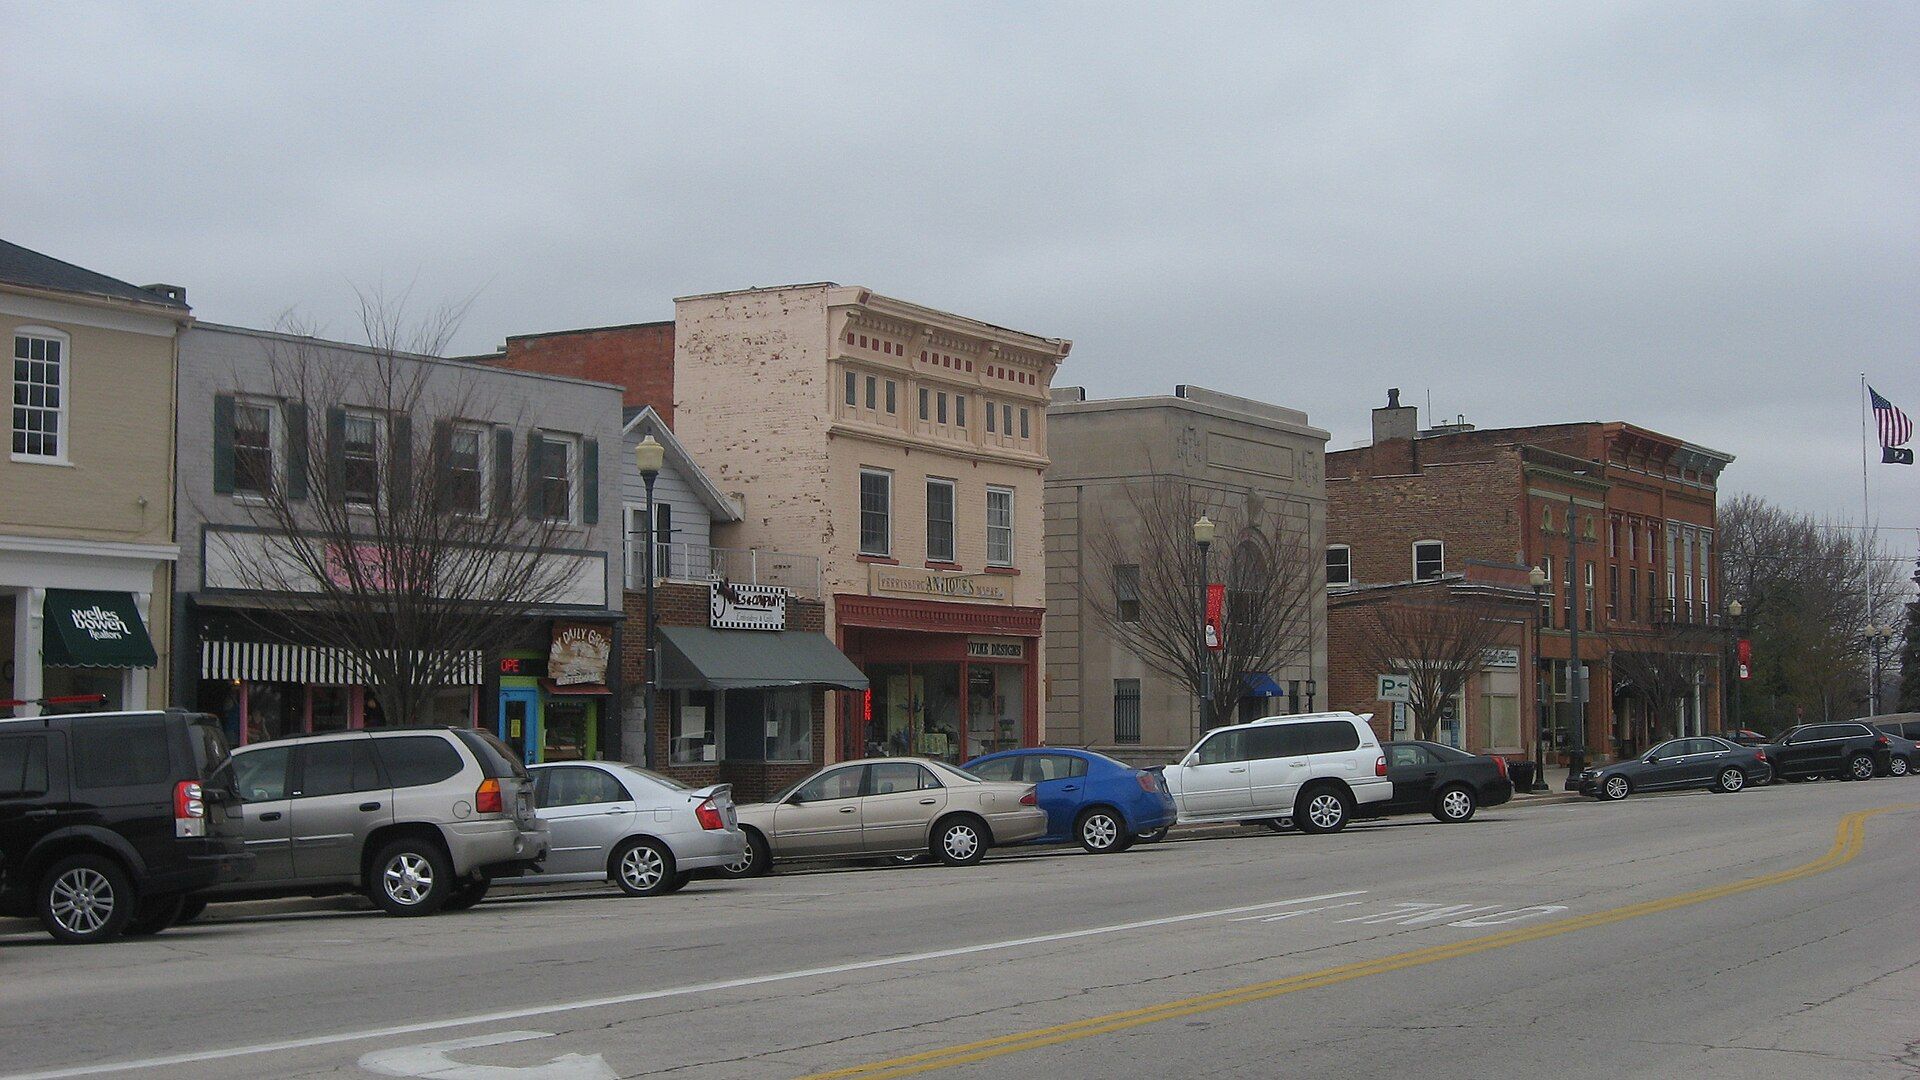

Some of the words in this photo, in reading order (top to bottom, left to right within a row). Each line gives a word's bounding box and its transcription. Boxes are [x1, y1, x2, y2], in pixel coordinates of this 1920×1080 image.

[71, 605, 120, 621] welles
[71, 613, 132, 635] bowen
[88, 628, 123, 641] Realtors
[562, 628, 587, 645] DAILY
[1381, 678, 1396, 696] P
